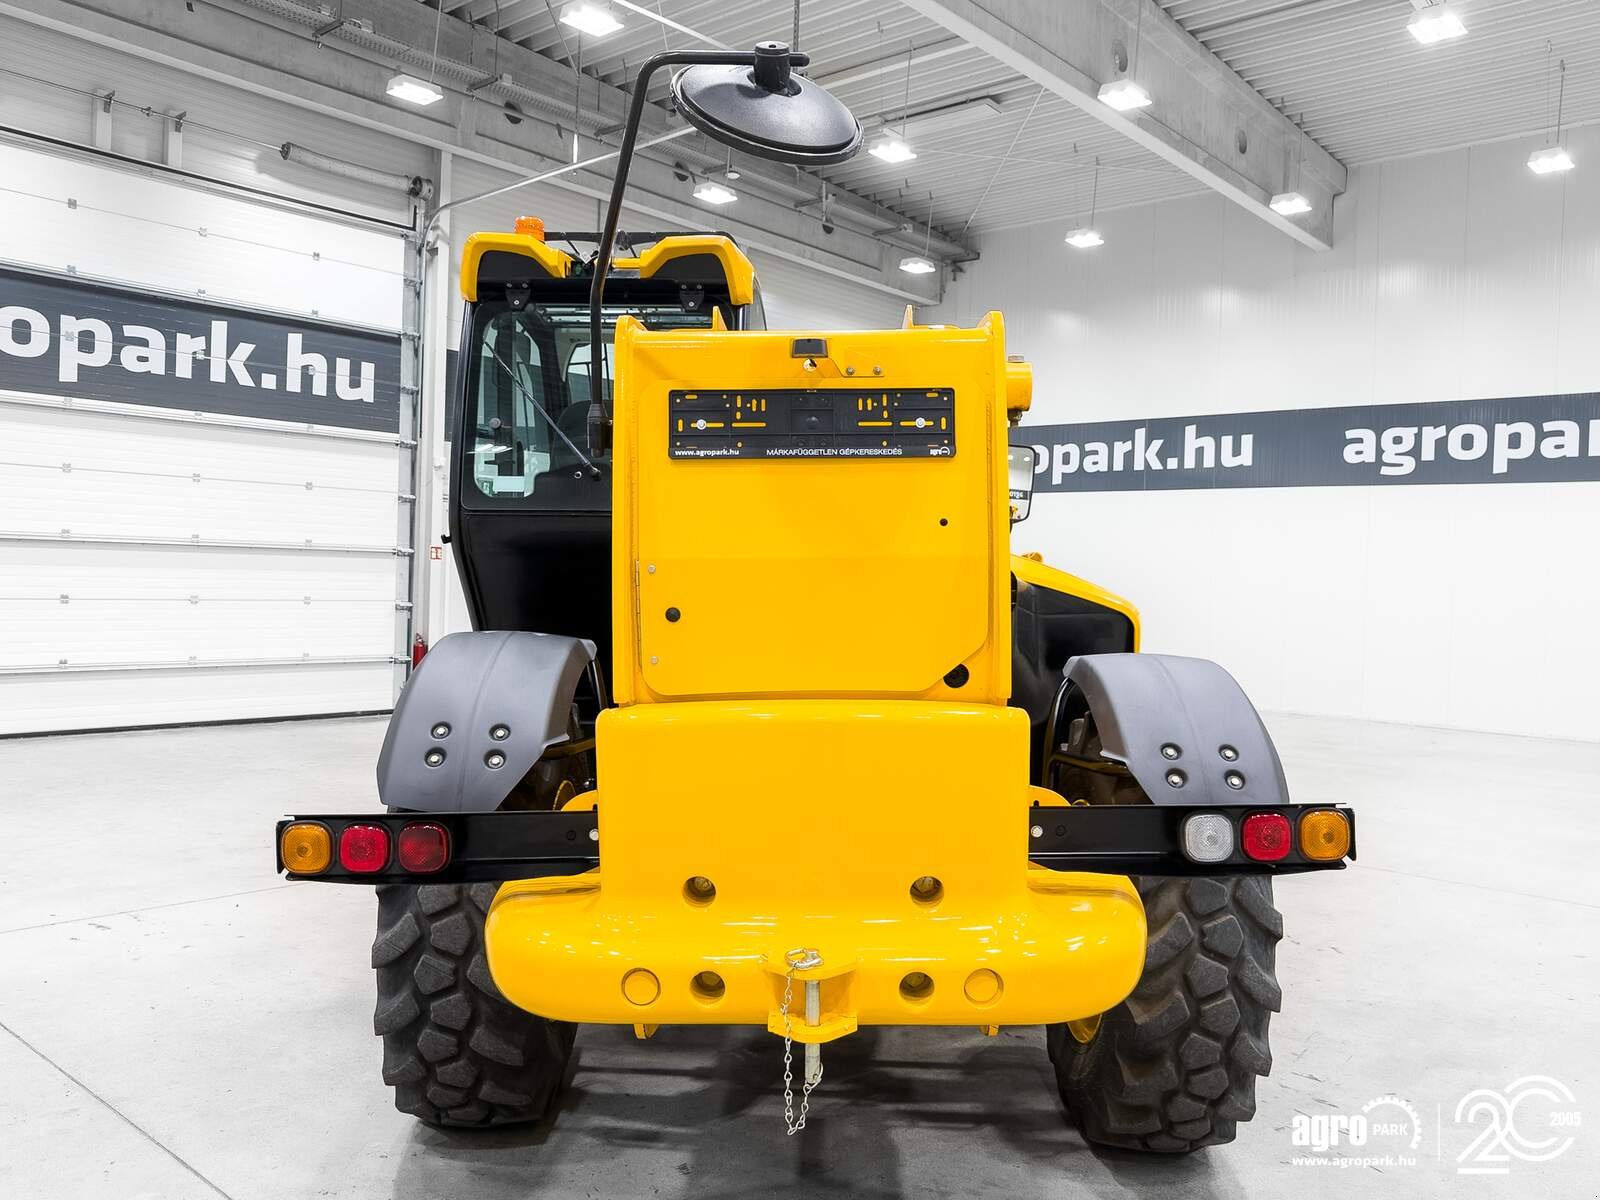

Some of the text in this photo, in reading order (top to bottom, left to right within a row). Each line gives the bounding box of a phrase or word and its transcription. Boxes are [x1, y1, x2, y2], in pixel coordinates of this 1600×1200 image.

[0, 306, 375, 402] opark.hu
[675, 448, 740, 457] www.agropark.hu
[766, 447, 903, 456] MÁRKAFÜGGETLEN GÉPKERESKEDÉS
[1031, 426, 1254, 485] opark.hu
